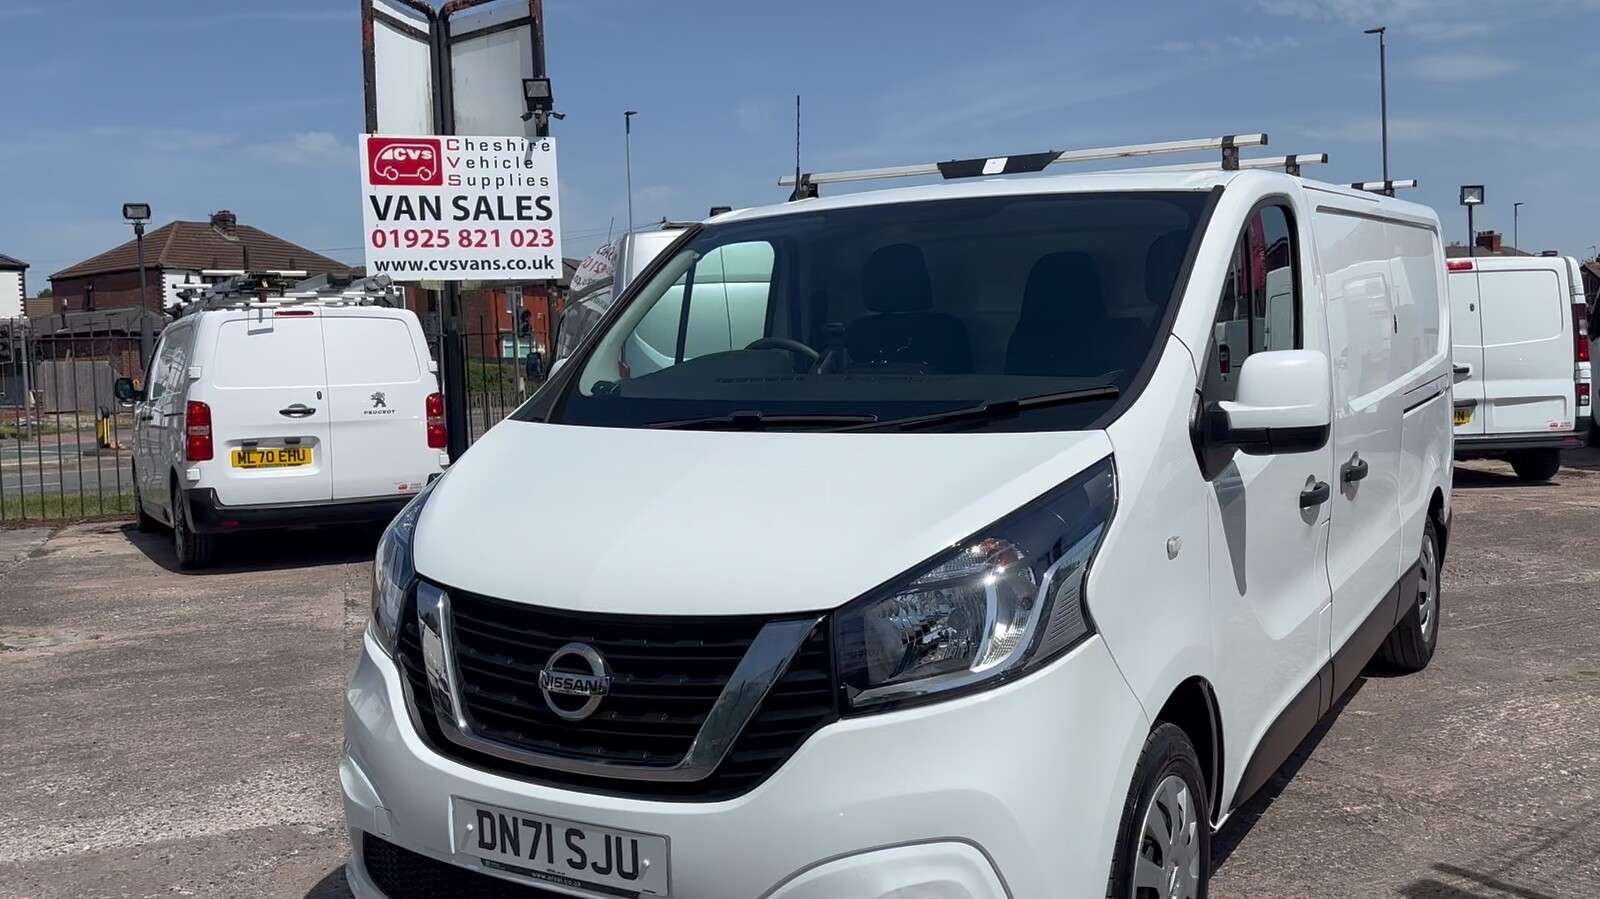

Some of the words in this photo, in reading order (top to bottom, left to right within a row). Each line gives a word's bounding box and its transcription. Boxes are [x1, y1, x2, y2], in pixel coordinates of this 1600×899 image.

[447, 138, 550, 151] Cheshire
[447, 156, 533, 168] Vehicle
[448, 174, 549, 189] Supplies
[370, 195, 442, 221] VAN
[452, 195, 553, 221] SALES
[371, 229, 449, 249] 01925
[458, 229, 501, 248] 821
[510, 229, 554, 248] 023
[374, 255, 555, 272] www.cvsvans.co.uk
[279, 449, 306, 462] EHU
[542, 675, 600, 692] NISSAN
[476, 809, 554, 865] DN71
[565, 828, 640, 881] SJU
